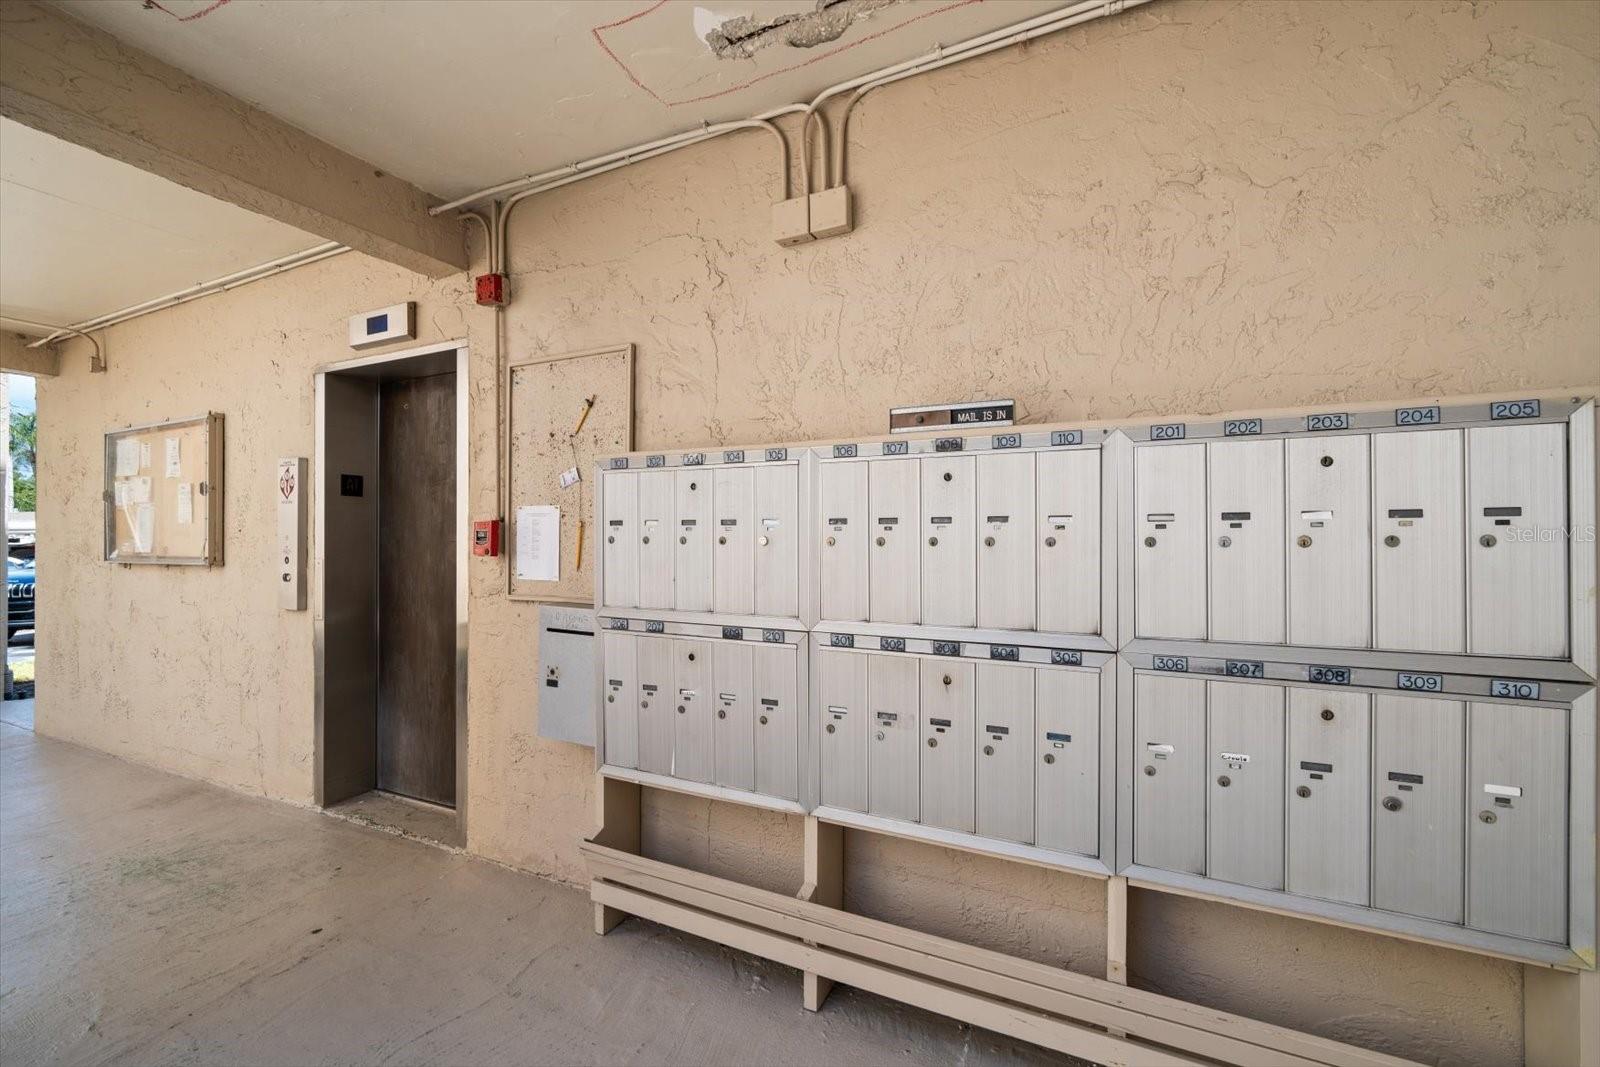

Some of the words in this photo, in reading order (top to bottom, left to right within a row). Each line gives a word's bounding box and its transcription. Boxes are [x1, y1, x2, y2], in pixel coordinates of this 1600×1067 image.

[957, 410, 979, 422] MAIL
[983, 410, 992, 421] IS
[996, 409, 1006, 420] IN
[1400, 408, 1436, 423] 204
[1495, 400, 1535, 418] 205
[1228, 420, 1258, 434] 202
[1311, 414, 1344, 429] 203
[1058, 432, 1075, 444] 110
[1156, 425, 1181, 438] 201
[996, 435, 1017, 448] 109
[767, 449, 783, 460] 105
[837, 446, 854, 457] 106
[886, 443, 904, 454] 107
[725, 451, 741, 462] 104
[613, 459, 625, 468] 101
[766, 631, 781, 641] 210
[833, 635, 852, 646] 301
[882, 638, 903, 650] 302
[936, 642, 957, 654] 303
[993, 646, 1016, 659] 304
[1054, 651, 1079, 664] 305
[1157, 657, 1185, 670] 306
[1229, 662, 1261, 676] 307
[1311, 667, 1345, 683] 308
[1402, 674, 1438, 690] 309
[1497, 682, 1532, 698] 310
